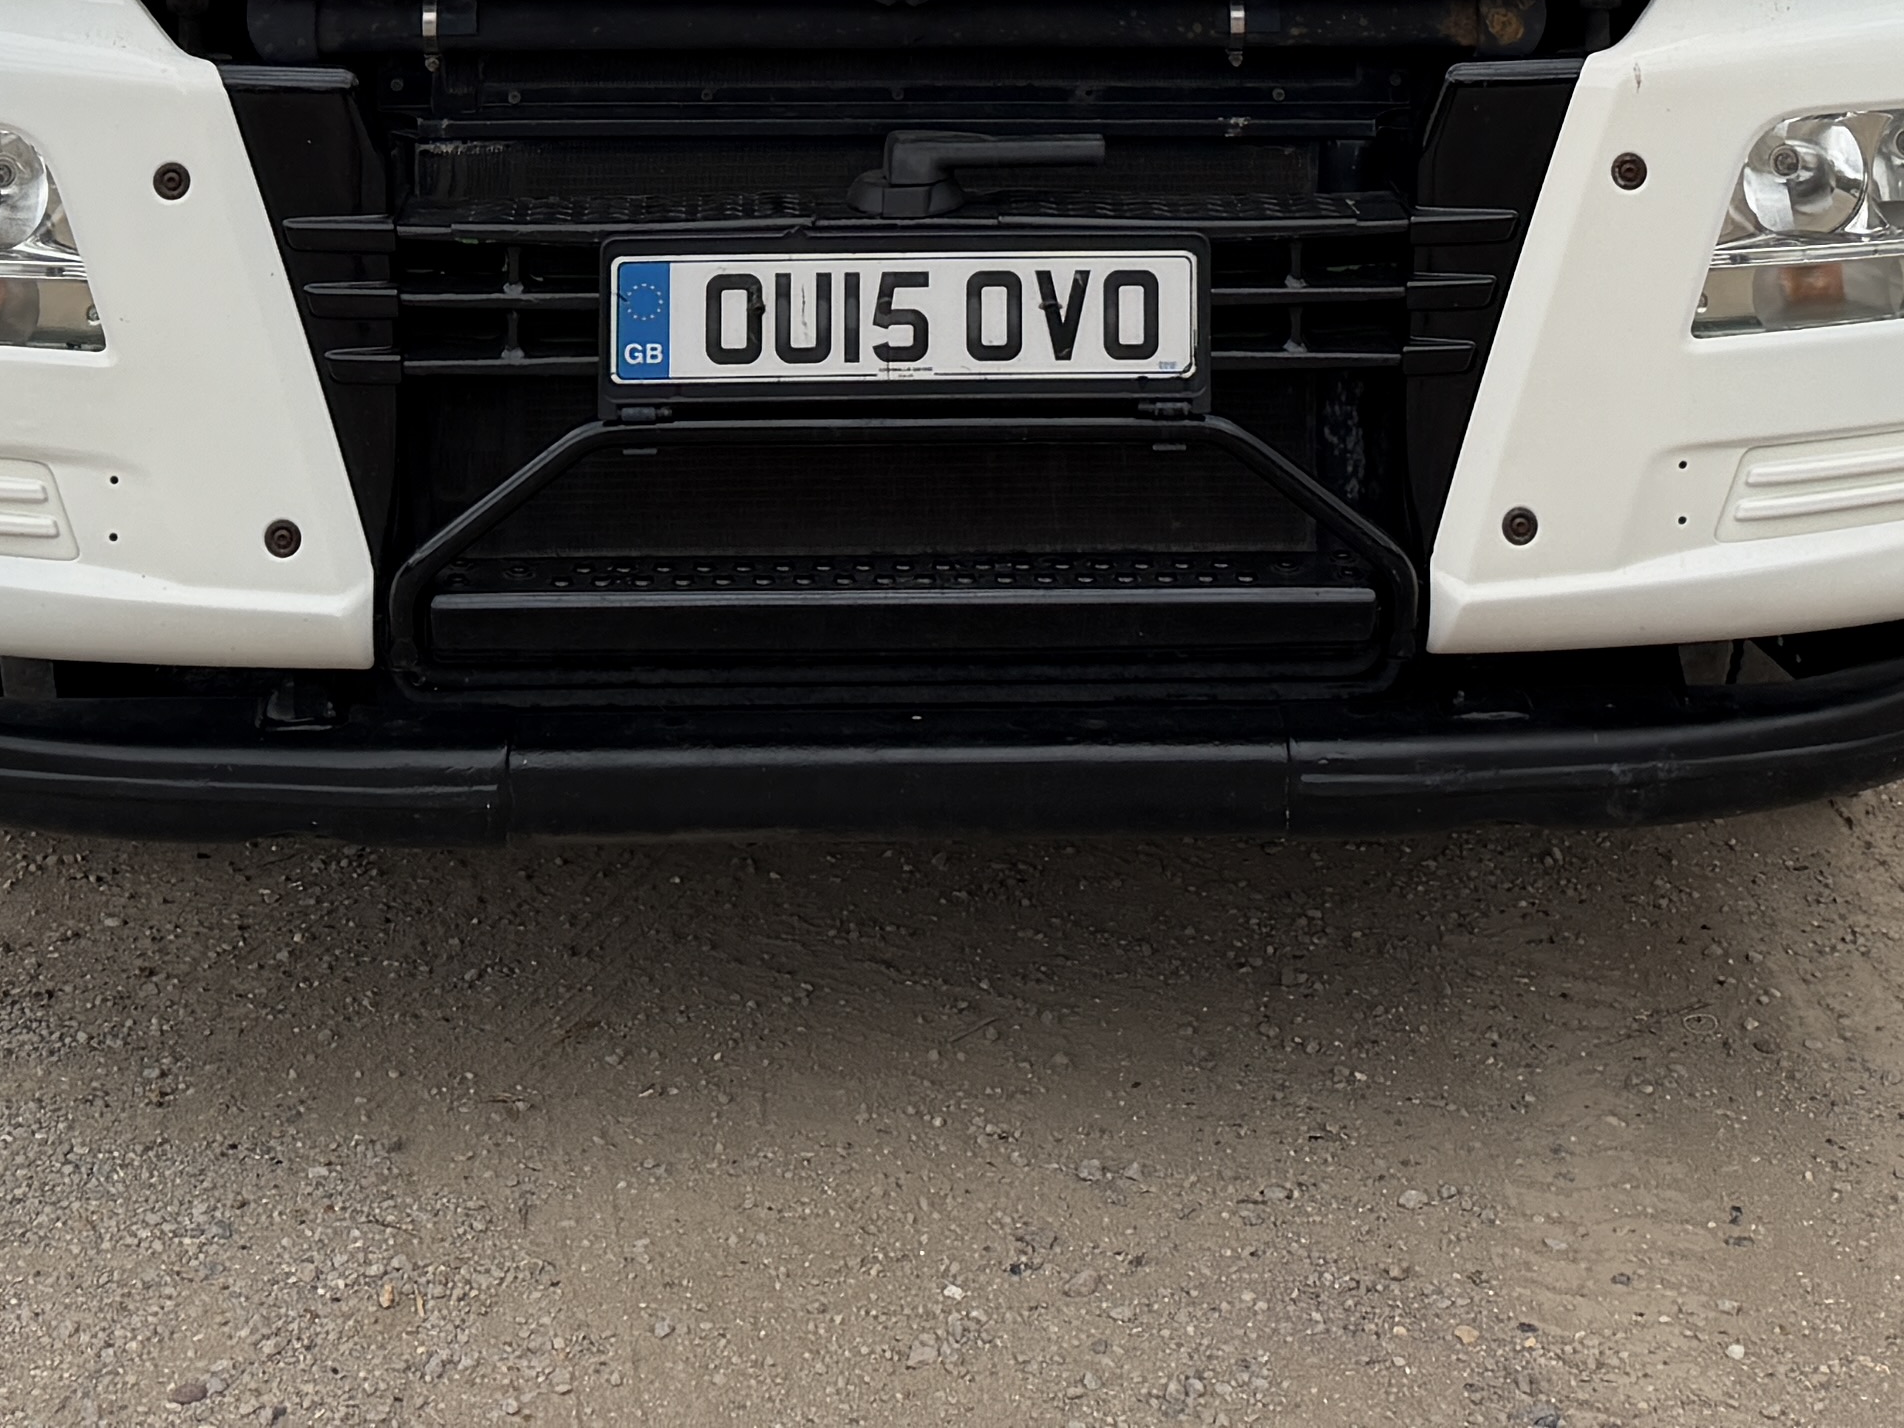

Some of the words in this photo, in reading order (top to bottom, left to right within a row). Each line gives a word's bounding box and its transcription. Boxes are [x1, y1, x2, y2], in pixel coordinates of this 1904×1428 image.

[704, 270, 930, 365] OU15
[964, 268, 1160, 363] OVO
[624, 343, 664, 365] GB
